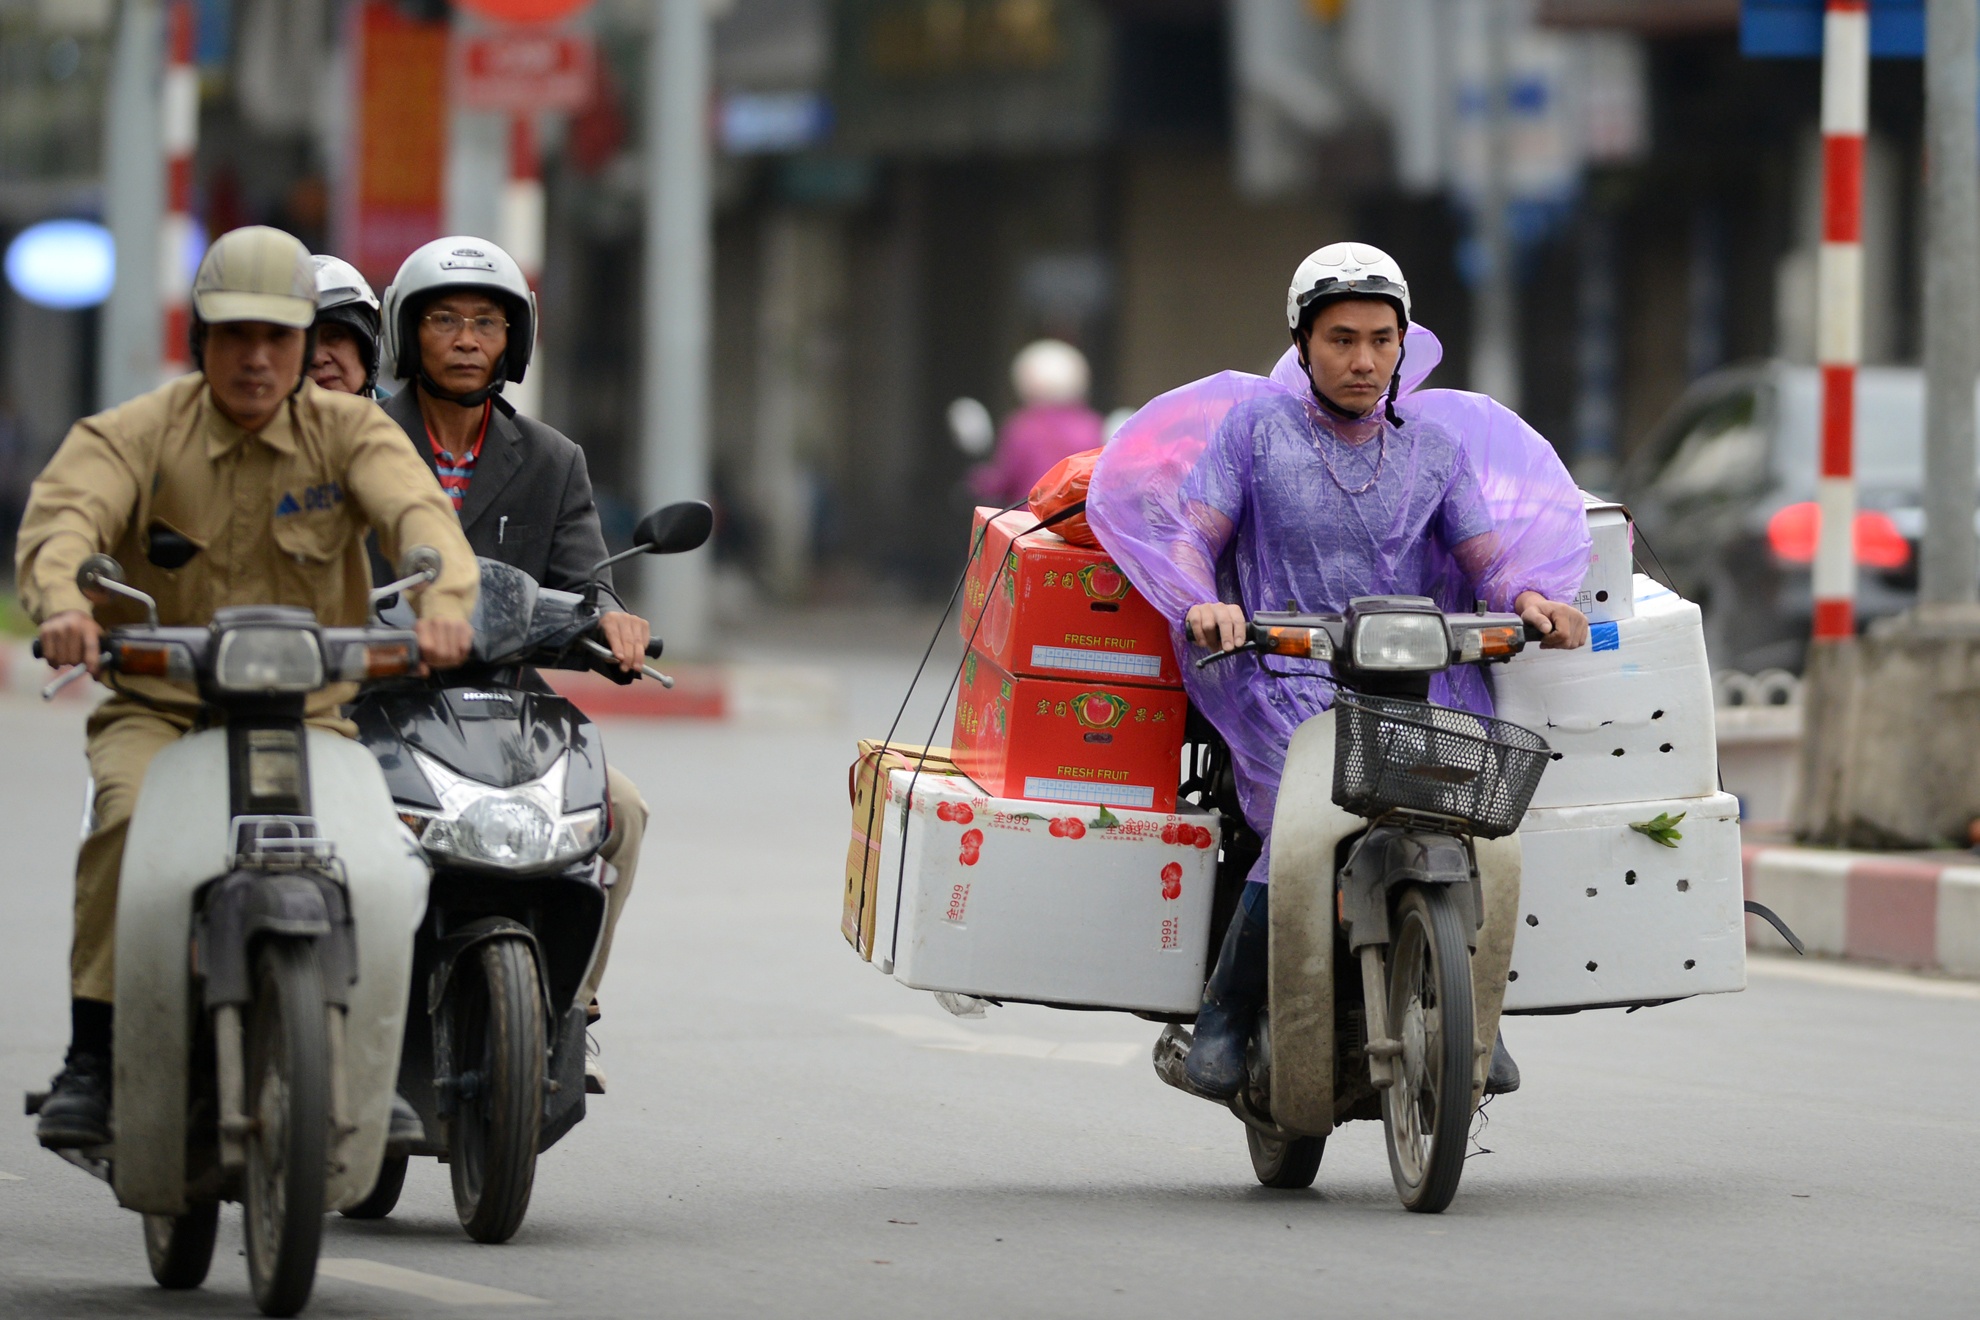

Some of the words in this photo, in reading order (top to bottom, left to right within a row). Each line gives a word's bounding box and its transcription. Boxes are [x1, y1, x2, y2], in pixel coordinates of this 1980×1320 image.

[1065, 634, 1102, 646] FRESH
[1105, 638, 1137, 649] FRUIT
[462, 692, 514, 704] HONDA
[1057, 765, 1094, 778] FRESH
[1098, 769, 1130, 781] FRUIT
[993, 811, 1030, 826] 全999
[946, 884, 963, 921] 全999
